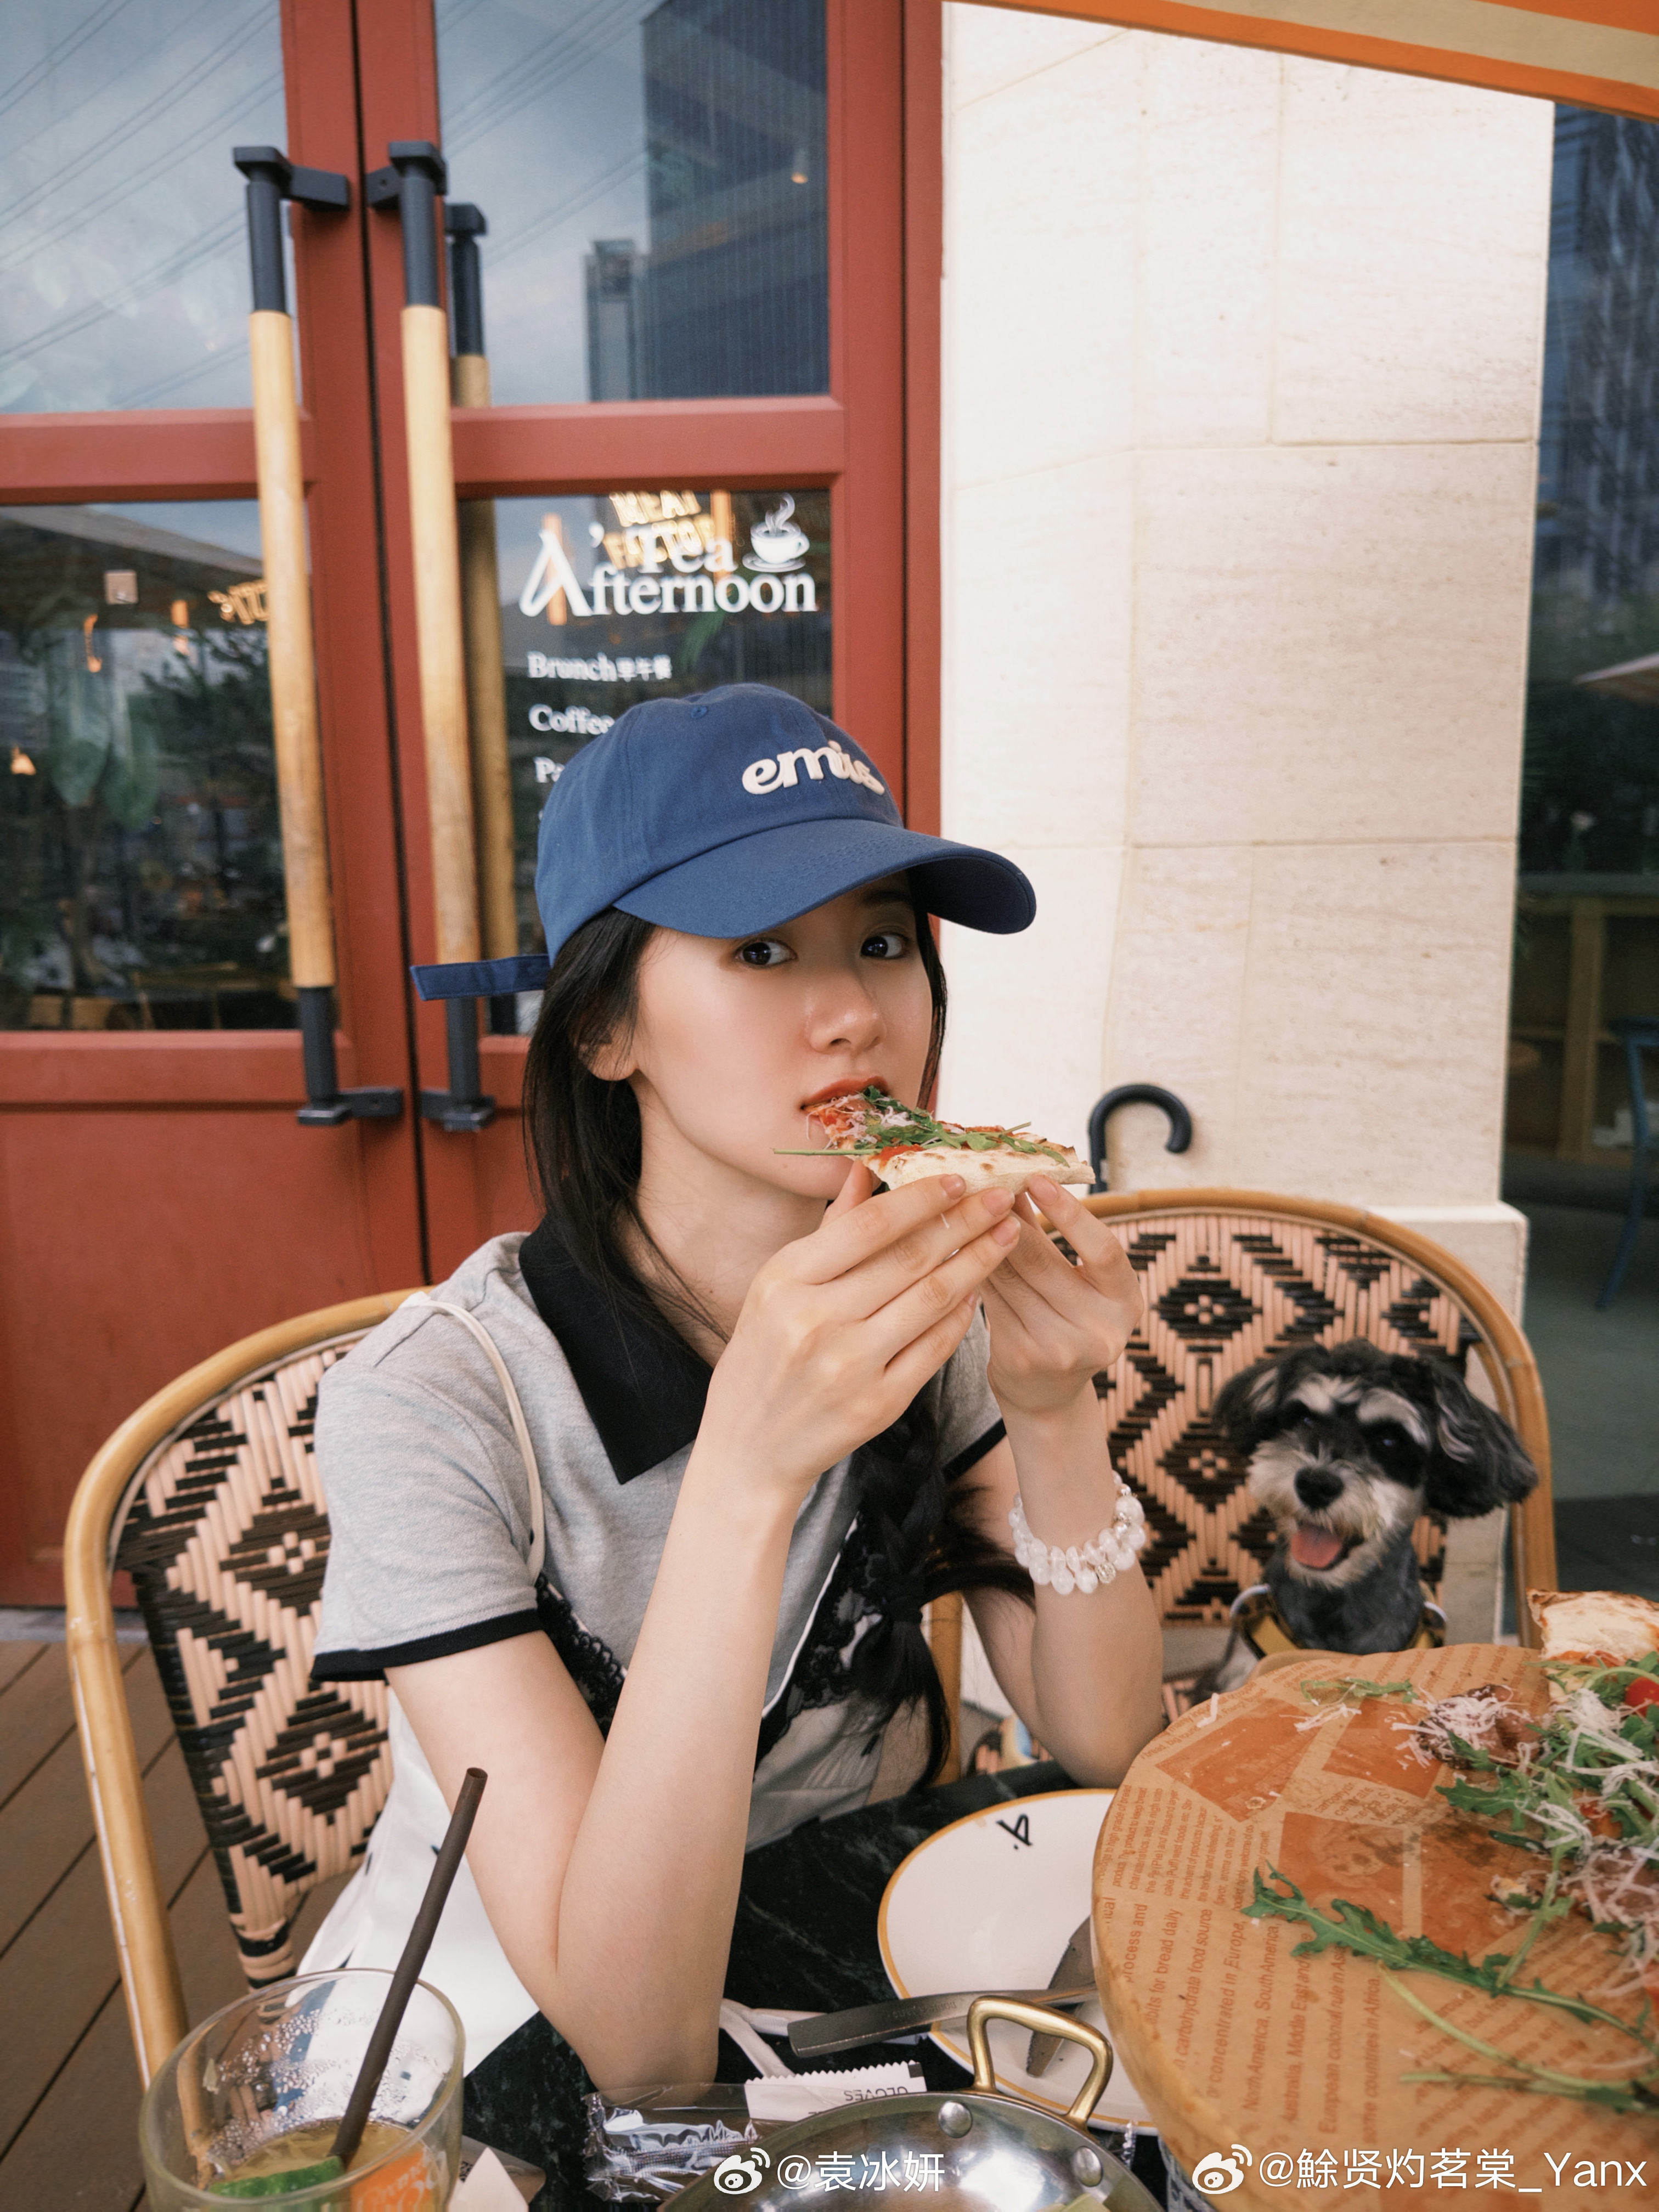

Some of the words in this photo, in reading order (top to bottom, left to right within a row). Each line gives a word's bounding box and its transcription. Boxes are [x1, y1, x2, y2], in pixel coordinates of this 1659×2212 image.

[624, 525, 738, 574] Tea
[1133, 1904, 1148, 1927] and
[1162, 1909, 1183, 1936] daily
[1196, 1909, 1212, 1946] source
[1153, 1939, 1174, 1974] bread
[1187, 1947, 1206, 1973] food
[1223, 1920, 1247, 1968] Europe,
[1259, 1923, 1281, 1973] America,
[1148, 1978, 1166, 1993] for
[1221, 1973, 1238, 1985] in
[1254, 1974, 1273, 2011] South
[1331, 1972, 1345, 1983] in
[1363, 1975, 1381, 2017] Africa.
[1285, 2014, 1306, 2057] Middle
[1296, 1960, 1311, 1983] and
[1331, 1985, 1345, 2008] rule
[1175, 1977, 1201, 2056] carbohydrate
[1208, 1987, 1235, 2083] concentrated
[1362, 2017, 1379, 2030] in
[1247, 2016, 1272, 2075] America,
[1362, 2032, 1379, 2097] countries
